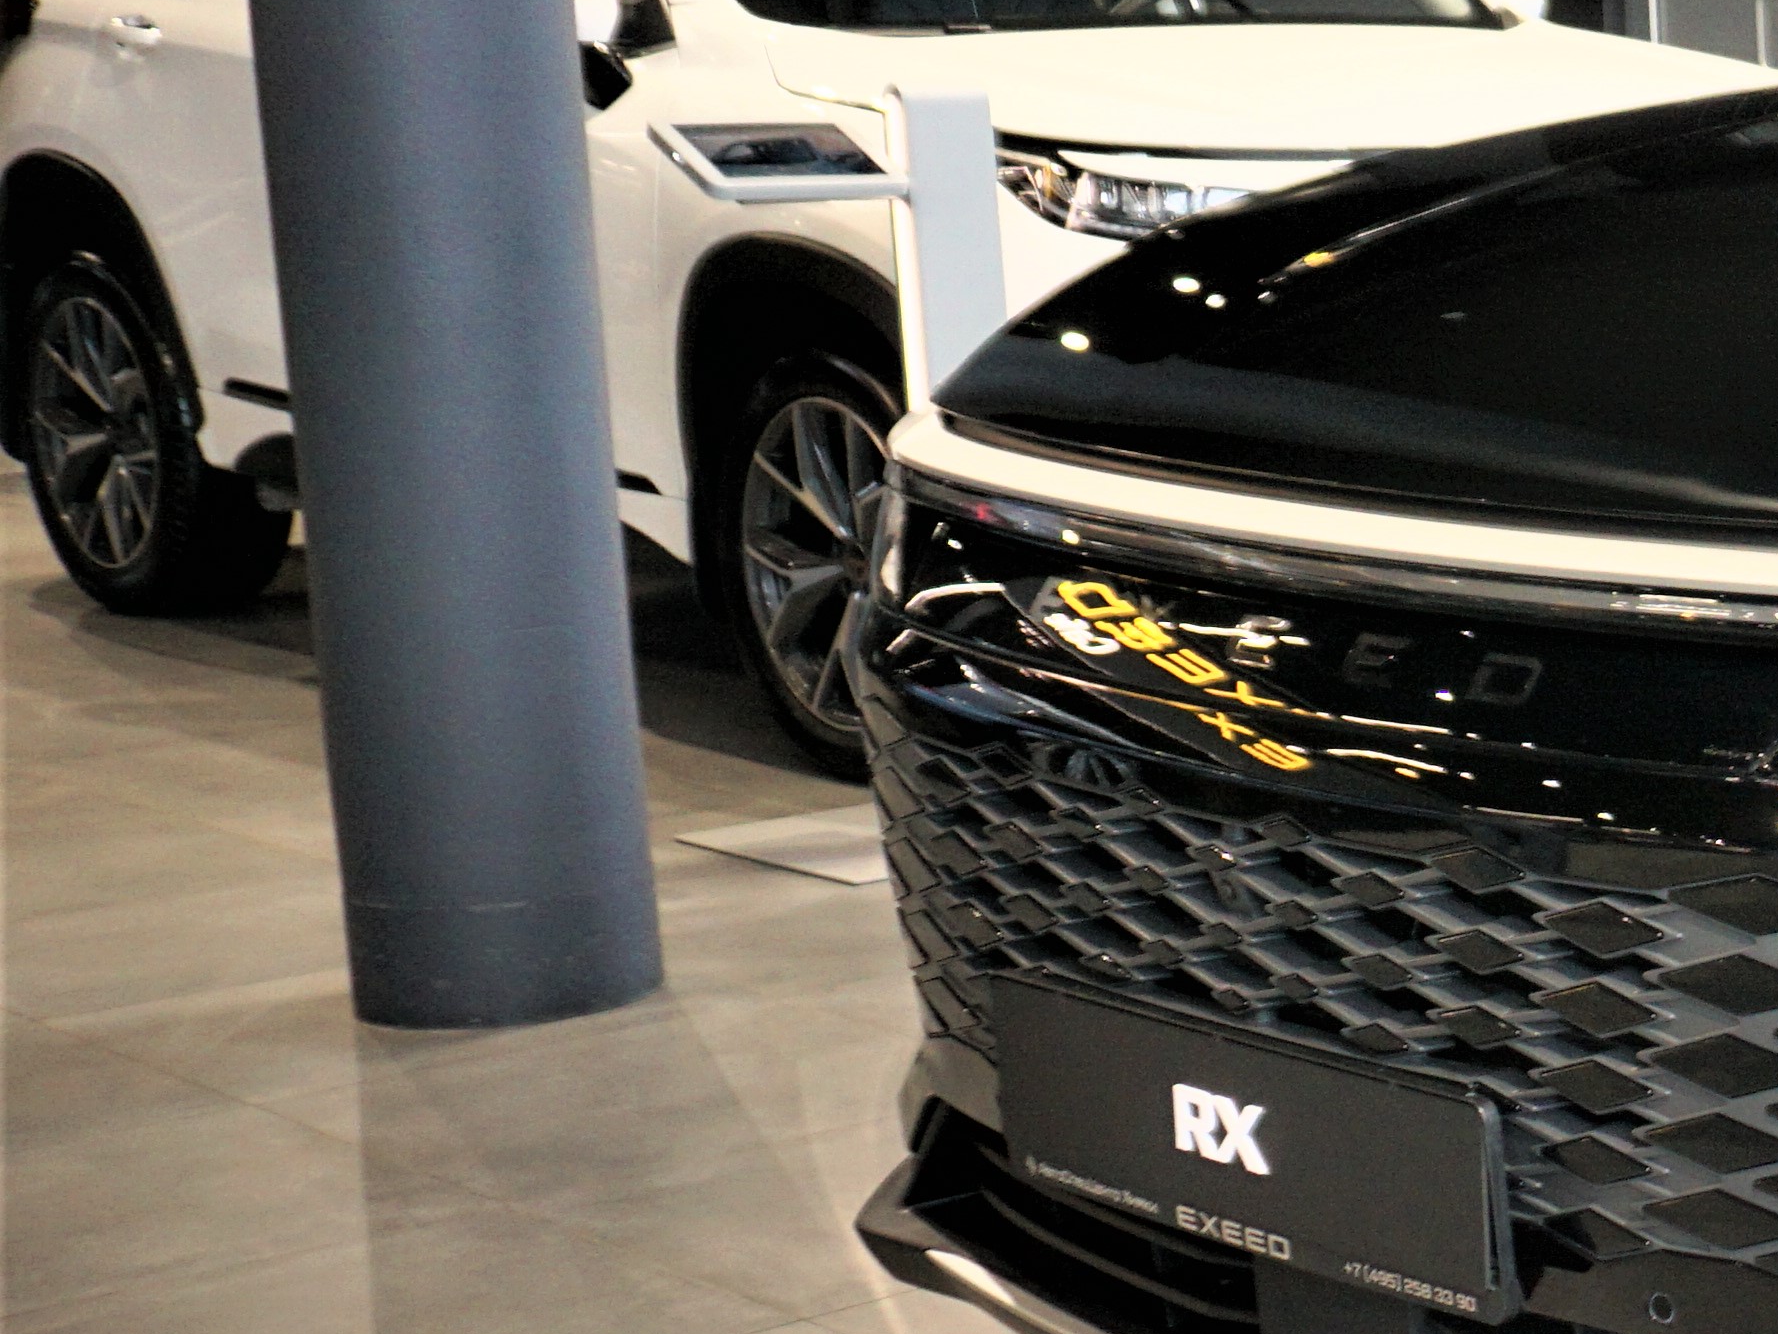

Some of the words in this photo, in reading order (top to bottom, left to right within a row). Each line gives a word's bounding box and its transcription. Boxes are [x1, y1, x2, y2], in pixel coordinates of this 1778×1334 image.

[1172, 1083, 1271, 1175] RX
[1174, 1204, 1293, 1258] EXEED
[1344, 1261, 1363, 1279] +7
